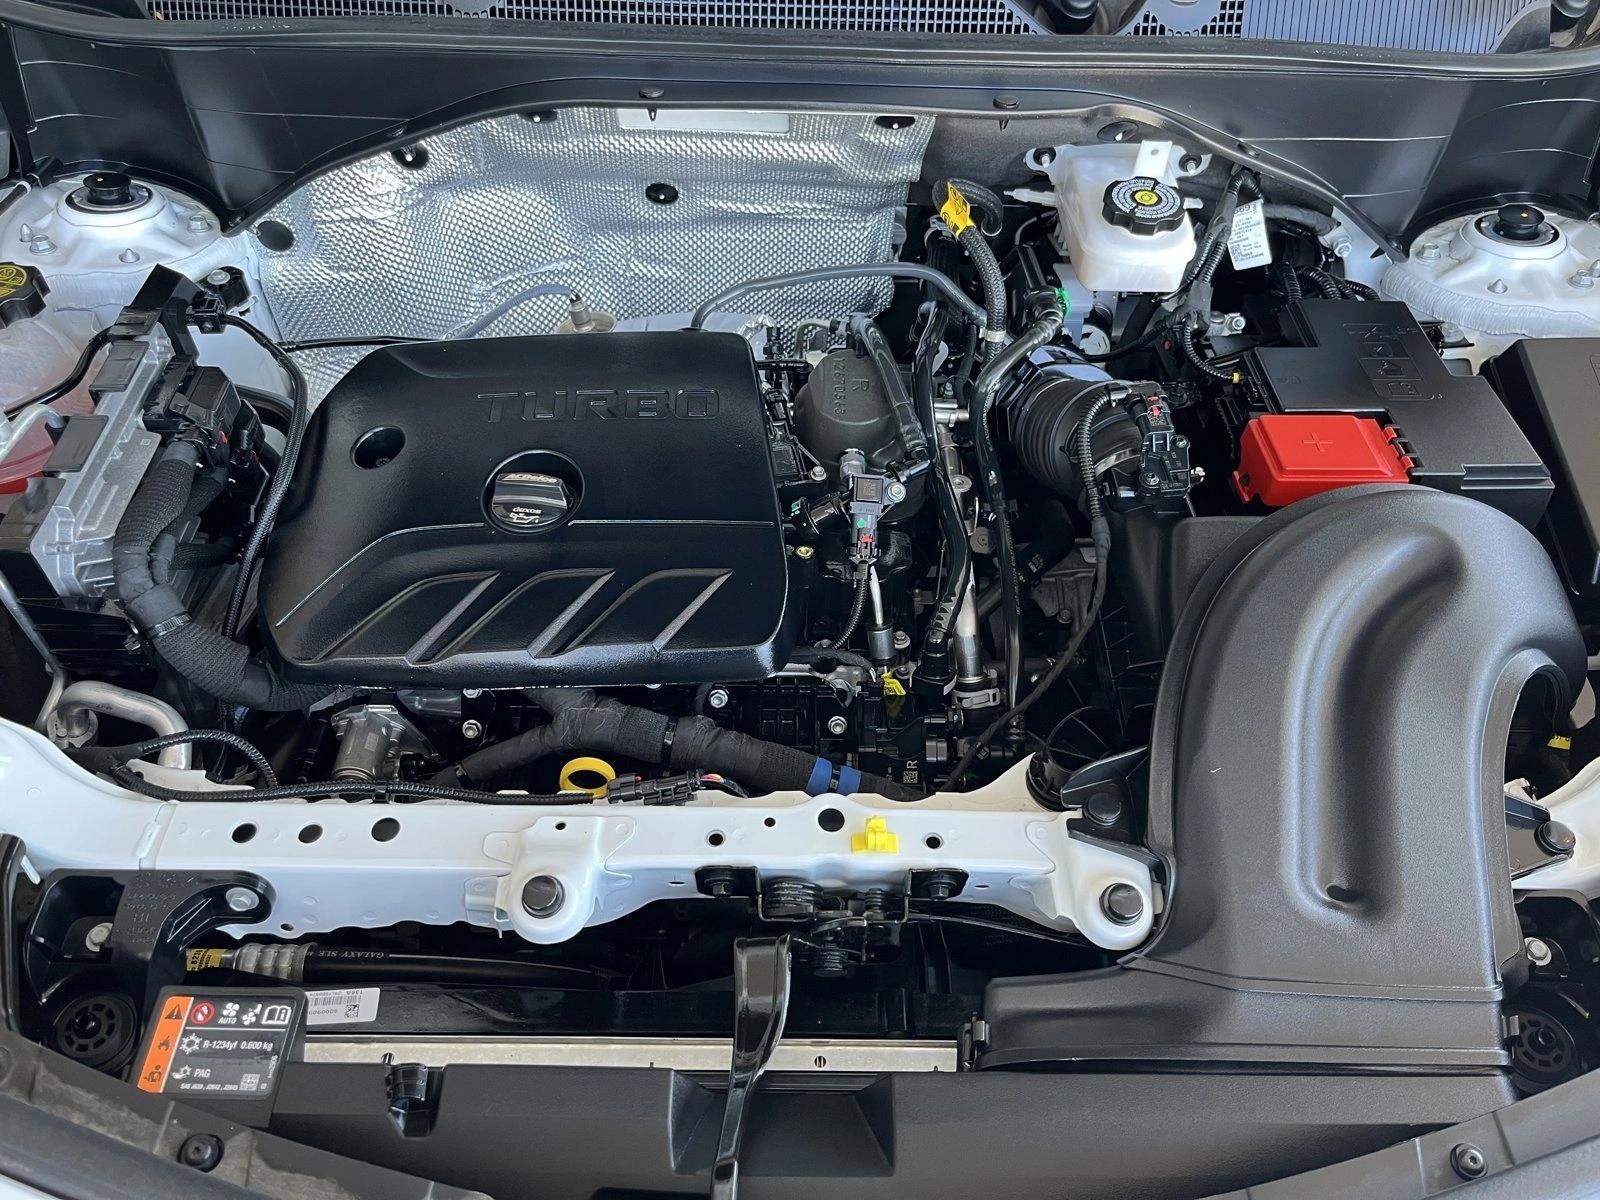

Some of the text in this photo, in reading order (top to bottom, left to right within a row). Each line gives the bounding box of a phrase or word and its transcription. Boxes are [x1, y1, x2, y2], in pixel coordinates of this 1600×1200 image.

[477, 389, 720, 423] TURBO
[512, 505, 542, 515] dexos
[318, 950, 338, 958] SLE
[340, 950, 385, 959] GALAXY
[218, 1017, 237, 1025] AUTO
[203, 1039, 274, 1052] R-1234yf 0.600 kg
[194, 1068, 211, 1079] PAG
